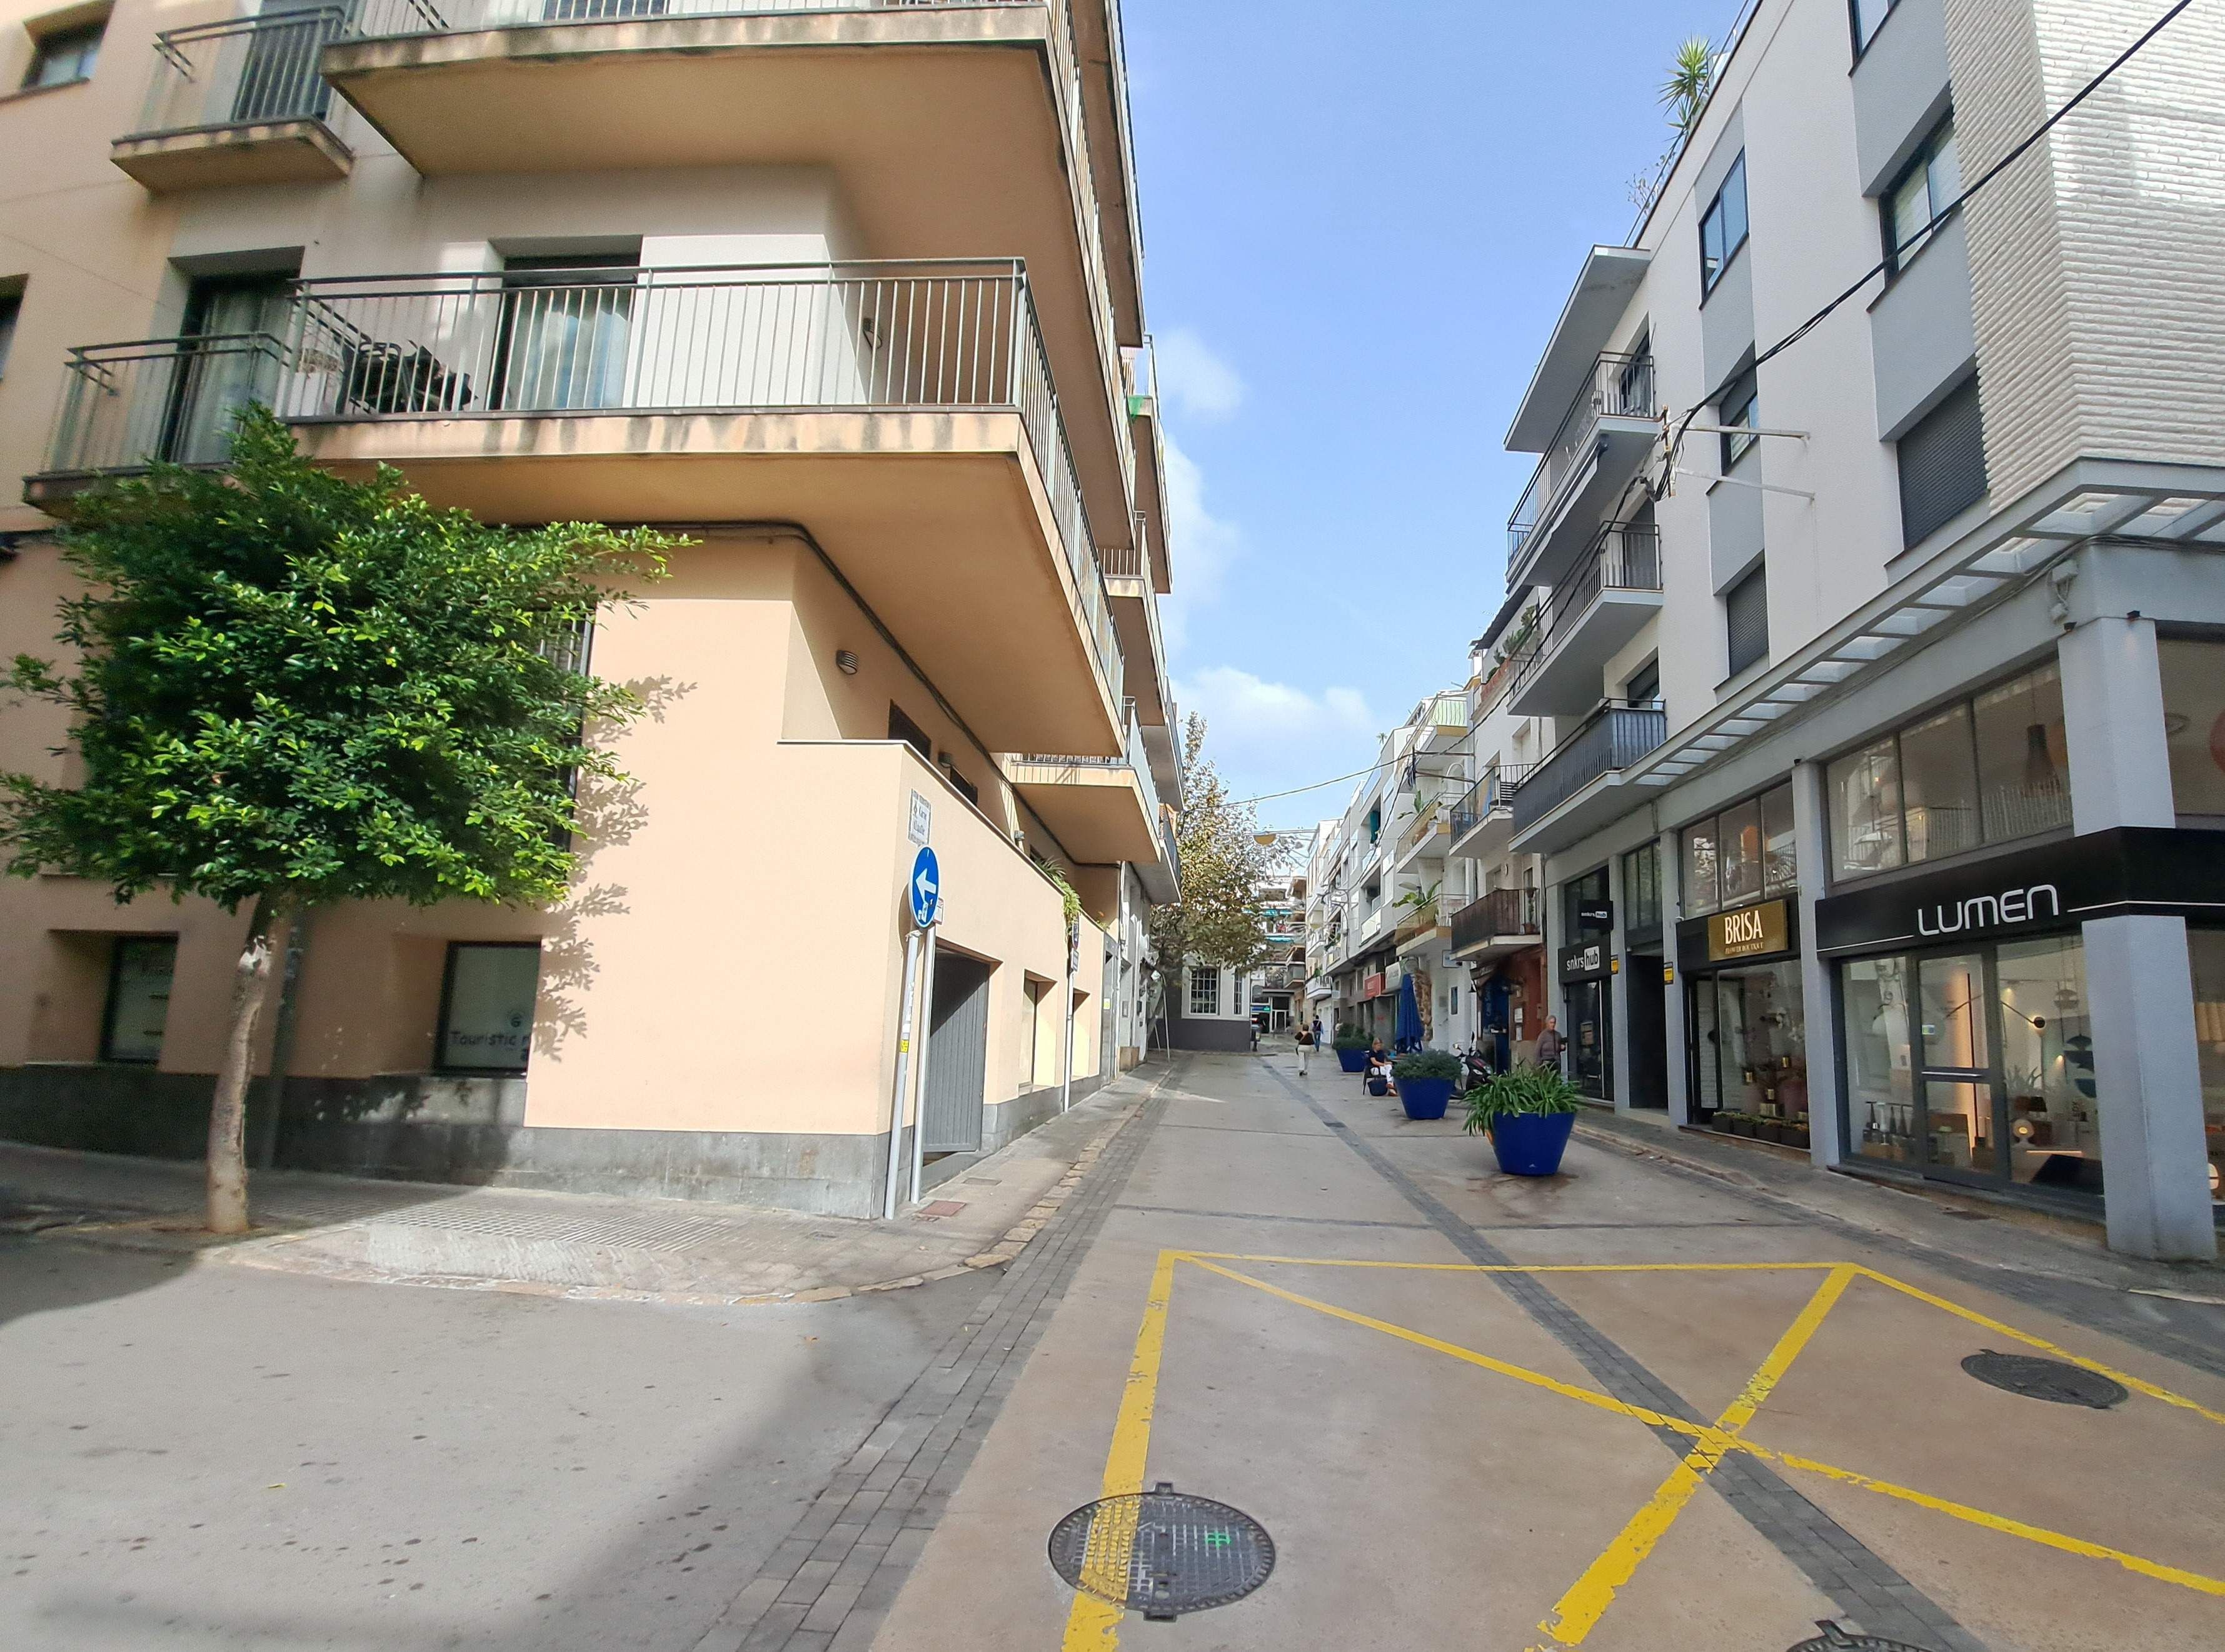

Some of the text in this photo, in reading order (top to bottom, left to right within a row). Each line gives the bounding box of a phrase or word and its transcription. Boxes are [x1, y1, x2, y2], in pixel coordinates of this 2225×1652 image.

[1724, 910, 1764, 944] BRISA
[1917, 884, 2059, 936] LUMEN
[1566, 955, 1584, 971] snkrs
[1585, 950, 1599, 968] hub
